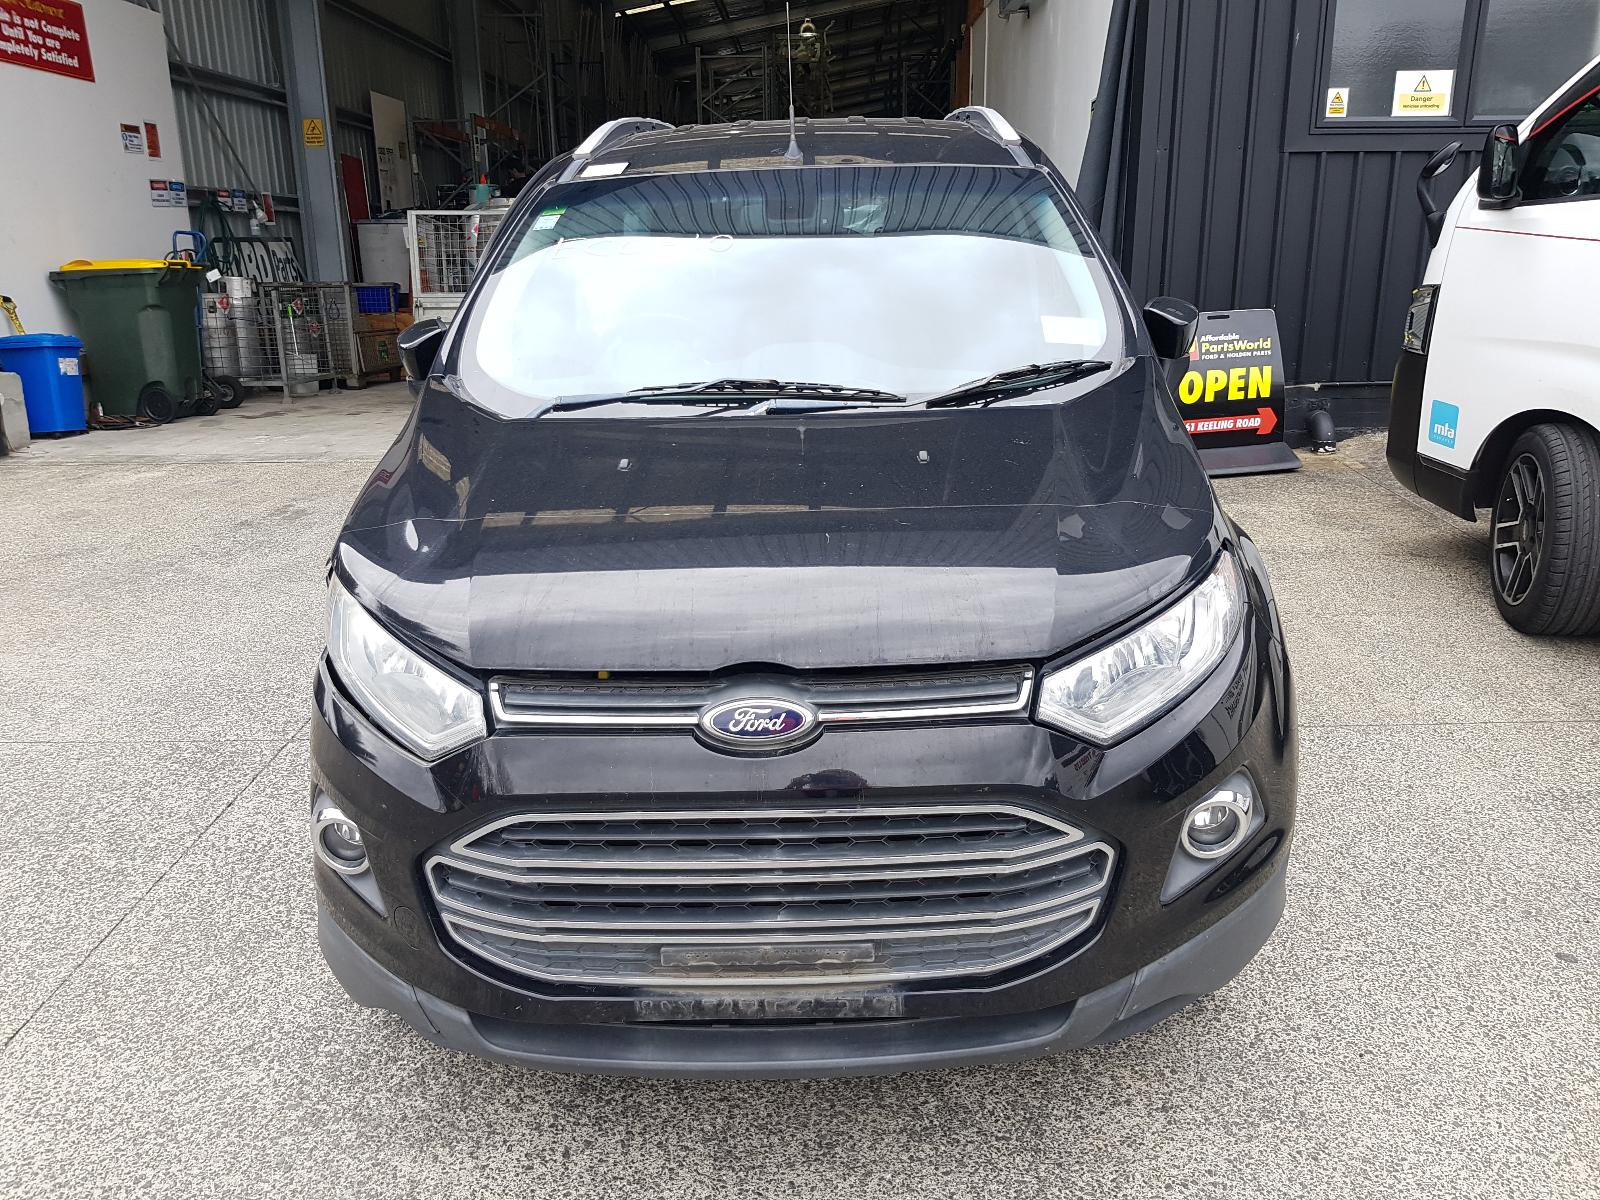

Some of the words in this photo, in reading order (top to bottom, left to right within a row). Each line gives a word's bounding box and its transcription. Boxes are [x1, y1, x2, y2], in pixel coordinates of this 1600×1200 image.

[1, 22, 25, 39] Until
[26, 29, 43, 44] You
[45, 38, 61, 49] are
[11, 10, 21, 24] is
[23, 17, 39, 29] not
[41, 20, 81, 41] Complete
[41, 48, 79, 68] Satisfied
[1411, 95, 1433, 103] Danger
[271, 249, 303, 283] Parts
[1200, 332, 1240, 342] Affordable
[1201, 338, 1272, 353] PartsWorld
[1227, 350, 1251, 358] HOLDEN
[1179, 365, 1272, 405] OPEN
[1197, 419, 1235, 431] KEELING
[1235, 417, 1261, 428] ROAD
[728, 707, 787, 732] Ford
